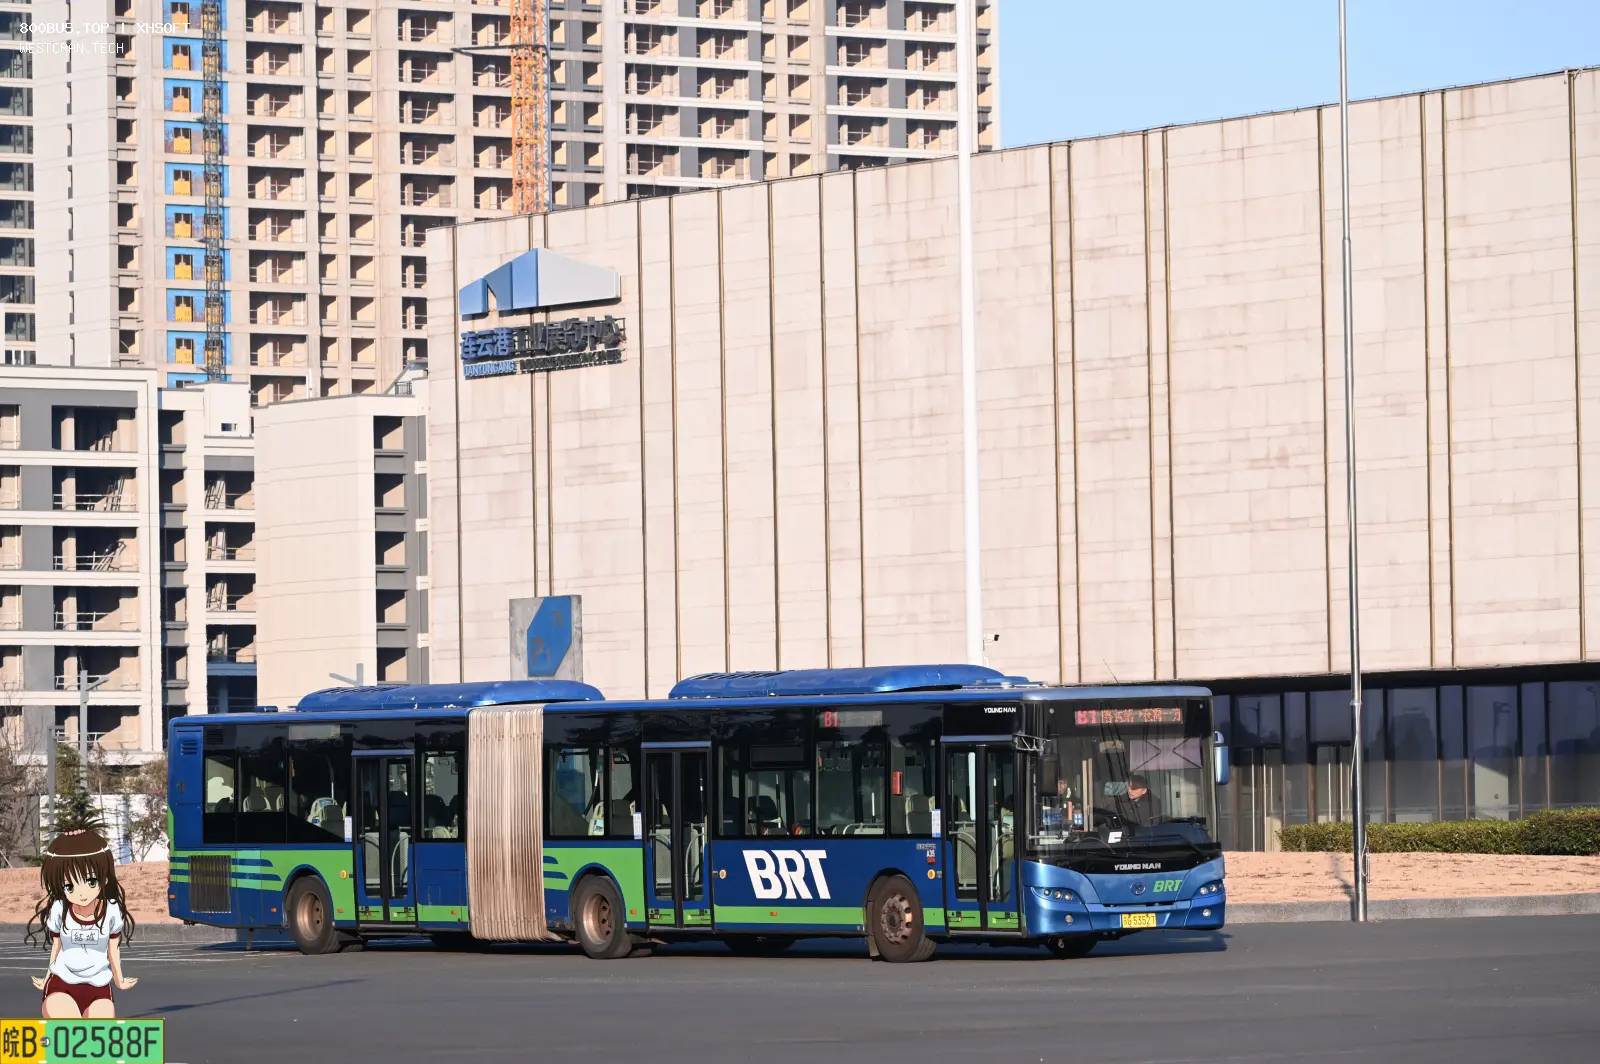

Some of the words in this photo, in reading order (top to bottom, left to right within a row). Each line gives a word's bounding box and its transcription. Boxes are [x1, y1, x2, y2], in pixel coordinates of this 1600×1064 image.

[824, 710, 839, 727] B1
[742, 849, 831, 899] BRT
[1153, 879, 1183, 893] BRT
